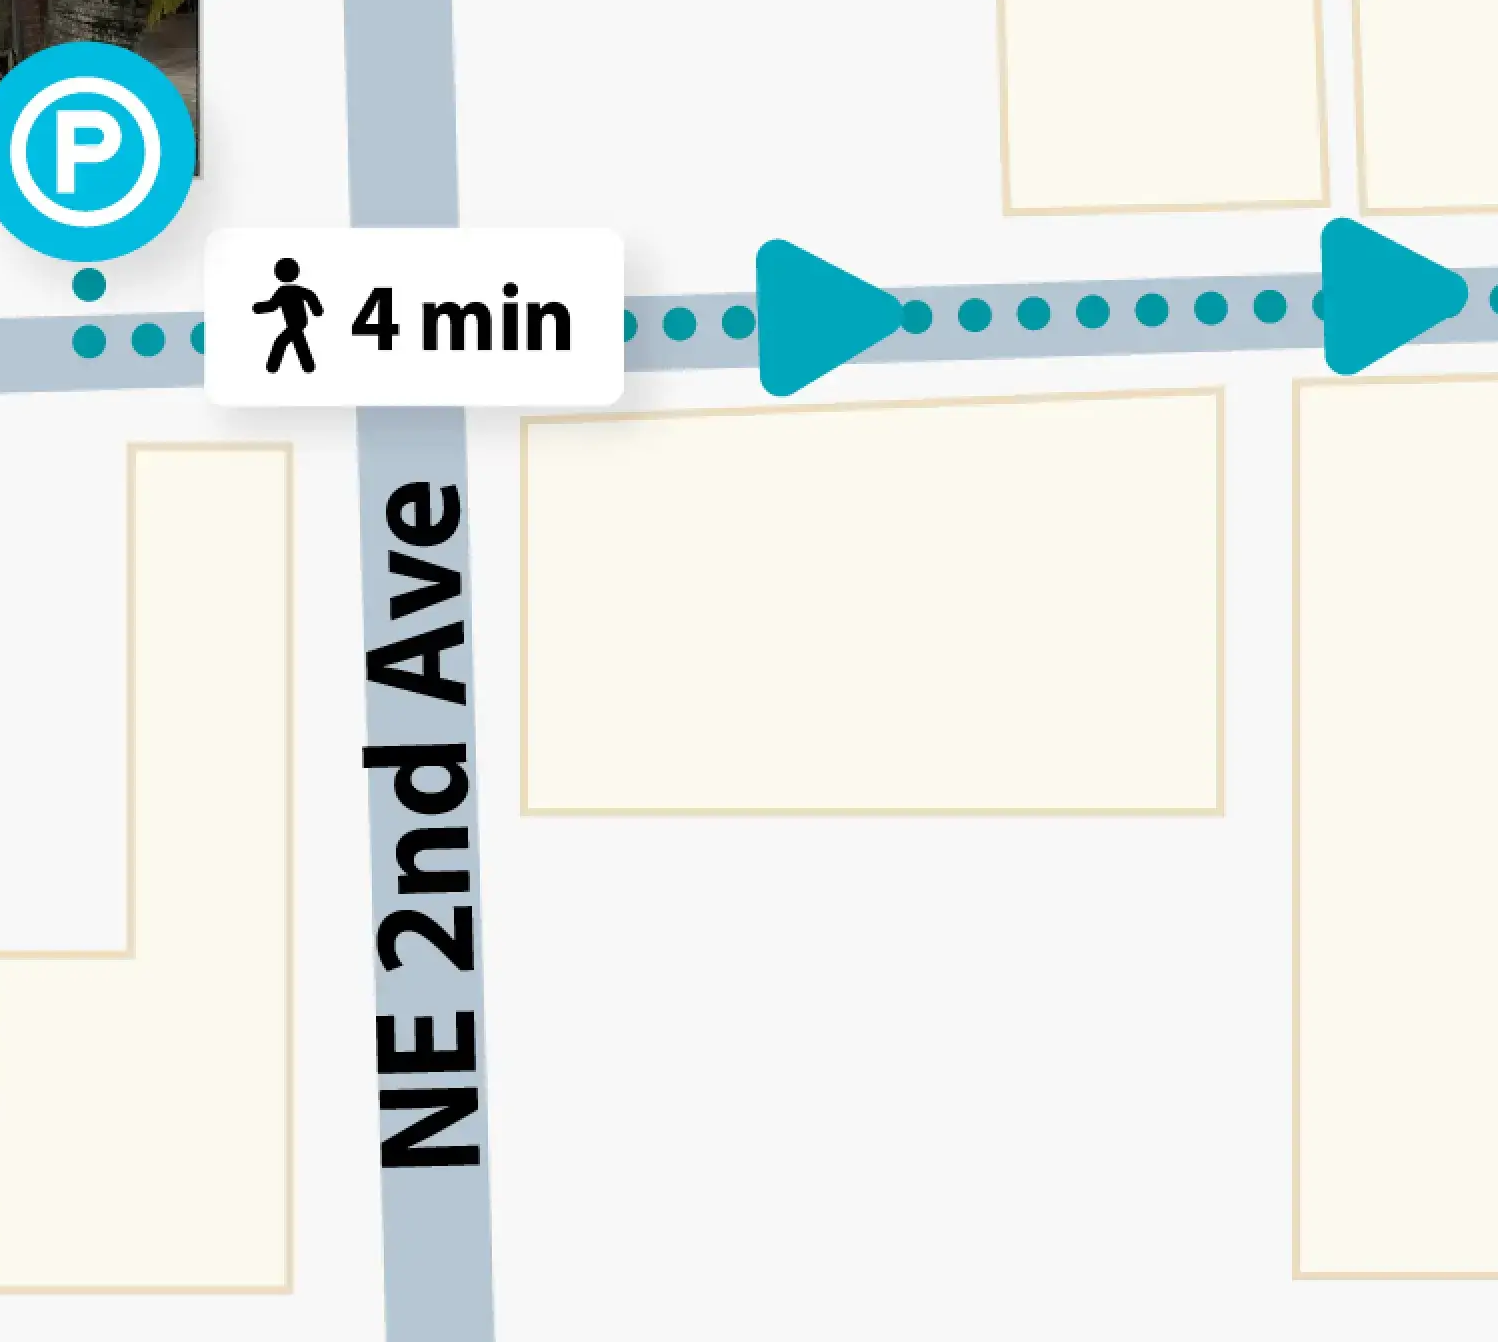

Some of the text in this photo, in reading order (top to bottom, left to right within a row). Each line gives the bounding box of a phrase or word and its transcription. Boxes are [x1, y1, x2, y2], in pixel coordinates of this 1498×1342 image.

[350, 280, 572, 352] 4 min
[360, 480, 482, 1170] NE 2nd Ave
